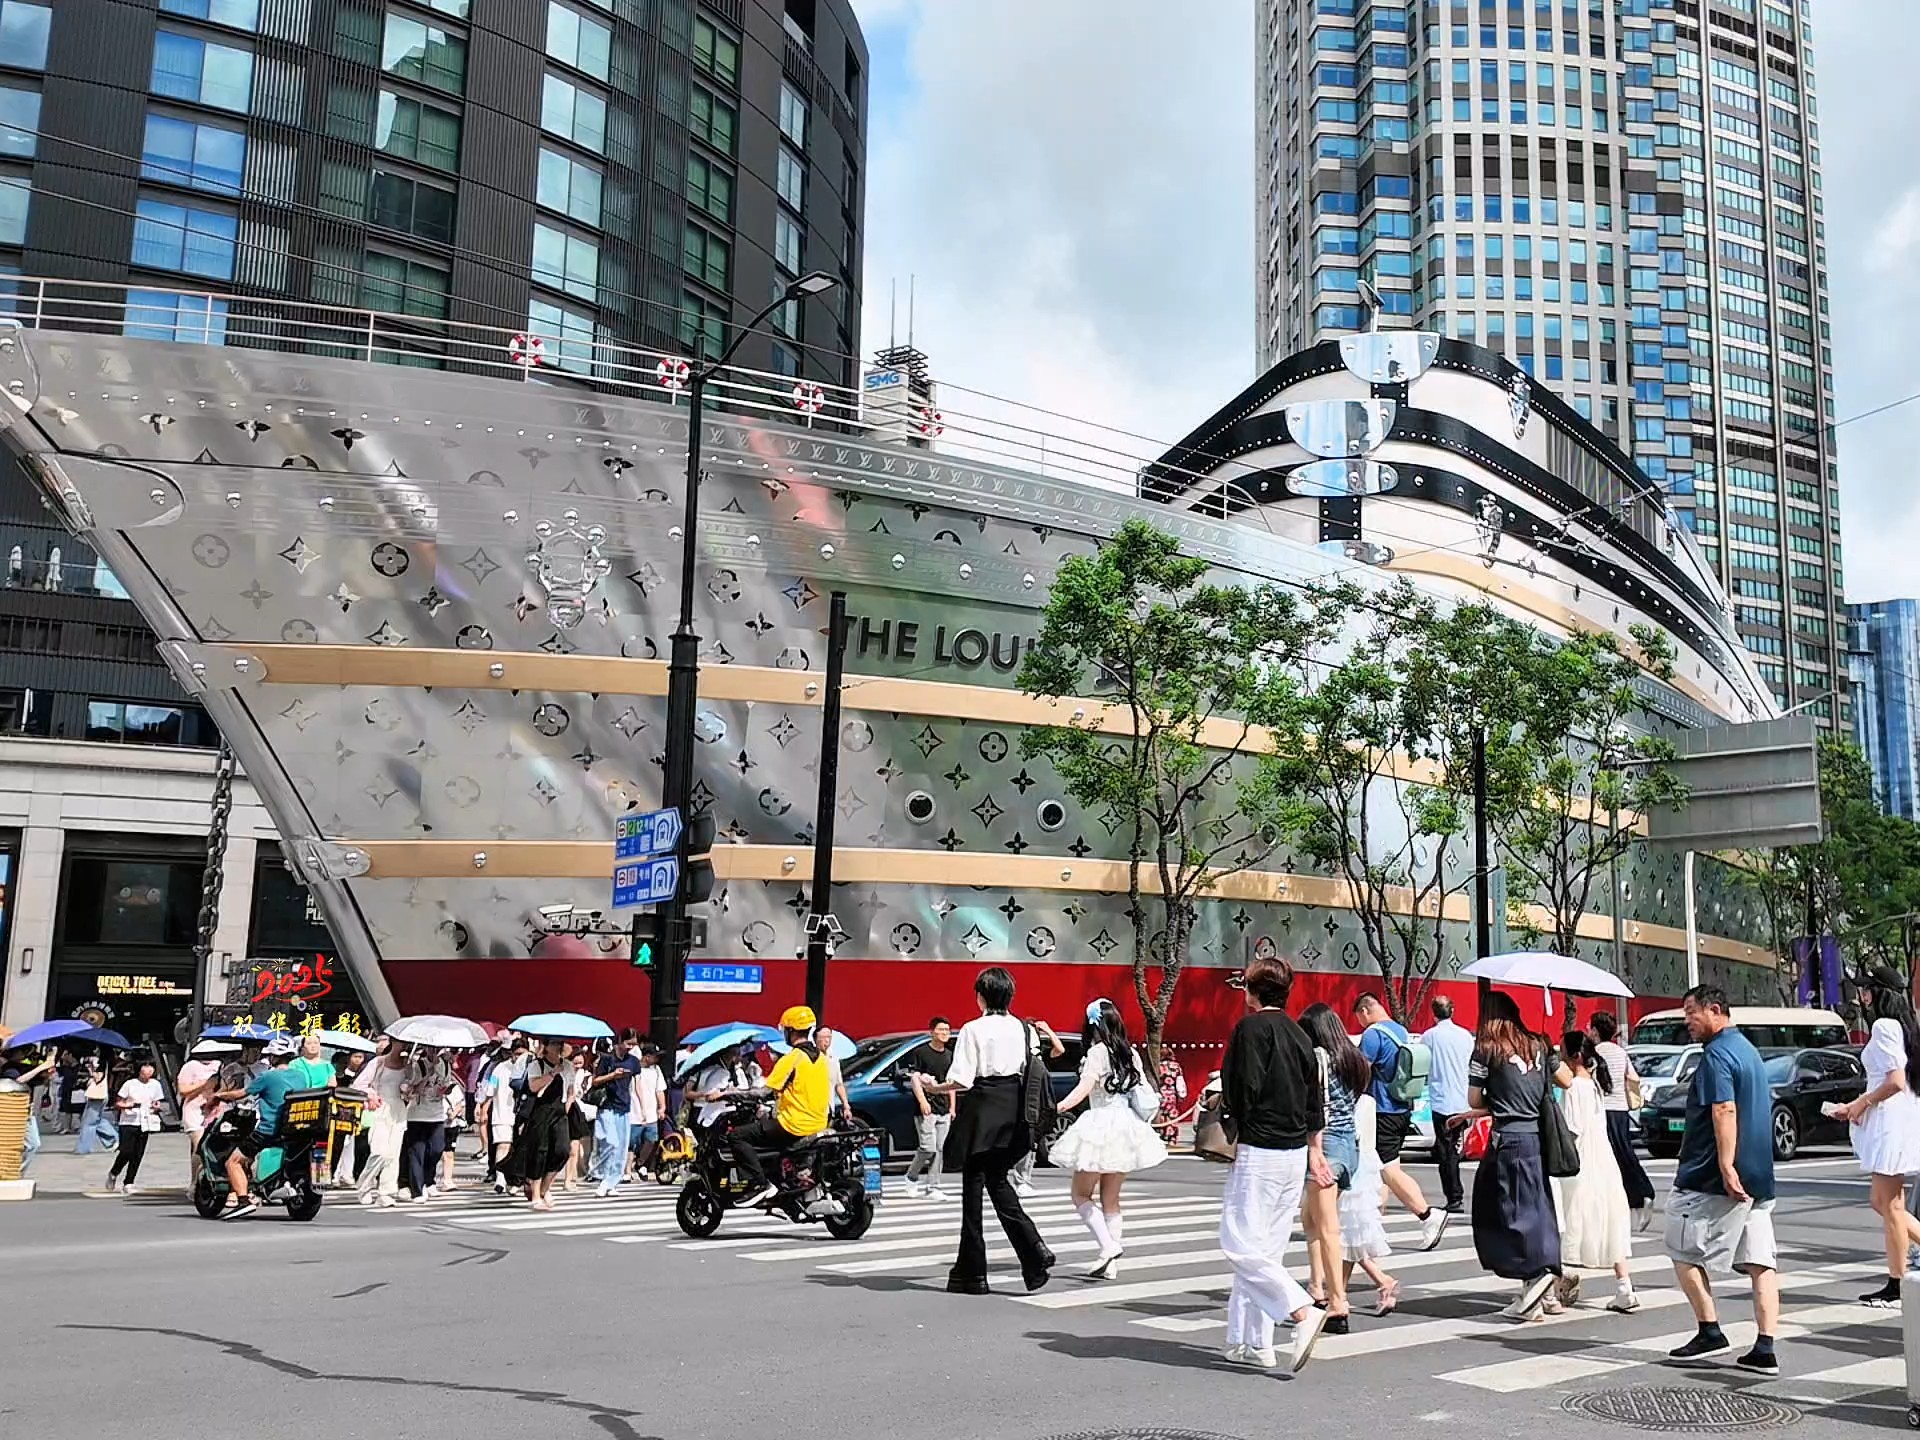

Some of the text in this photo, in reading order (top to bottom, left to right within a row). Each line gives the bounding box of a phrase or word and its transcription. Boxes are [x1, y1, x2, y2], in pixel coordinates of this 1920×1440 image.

[866, 371, 900, 388] SMG
[701, 967, 745, 981] 石门一路
